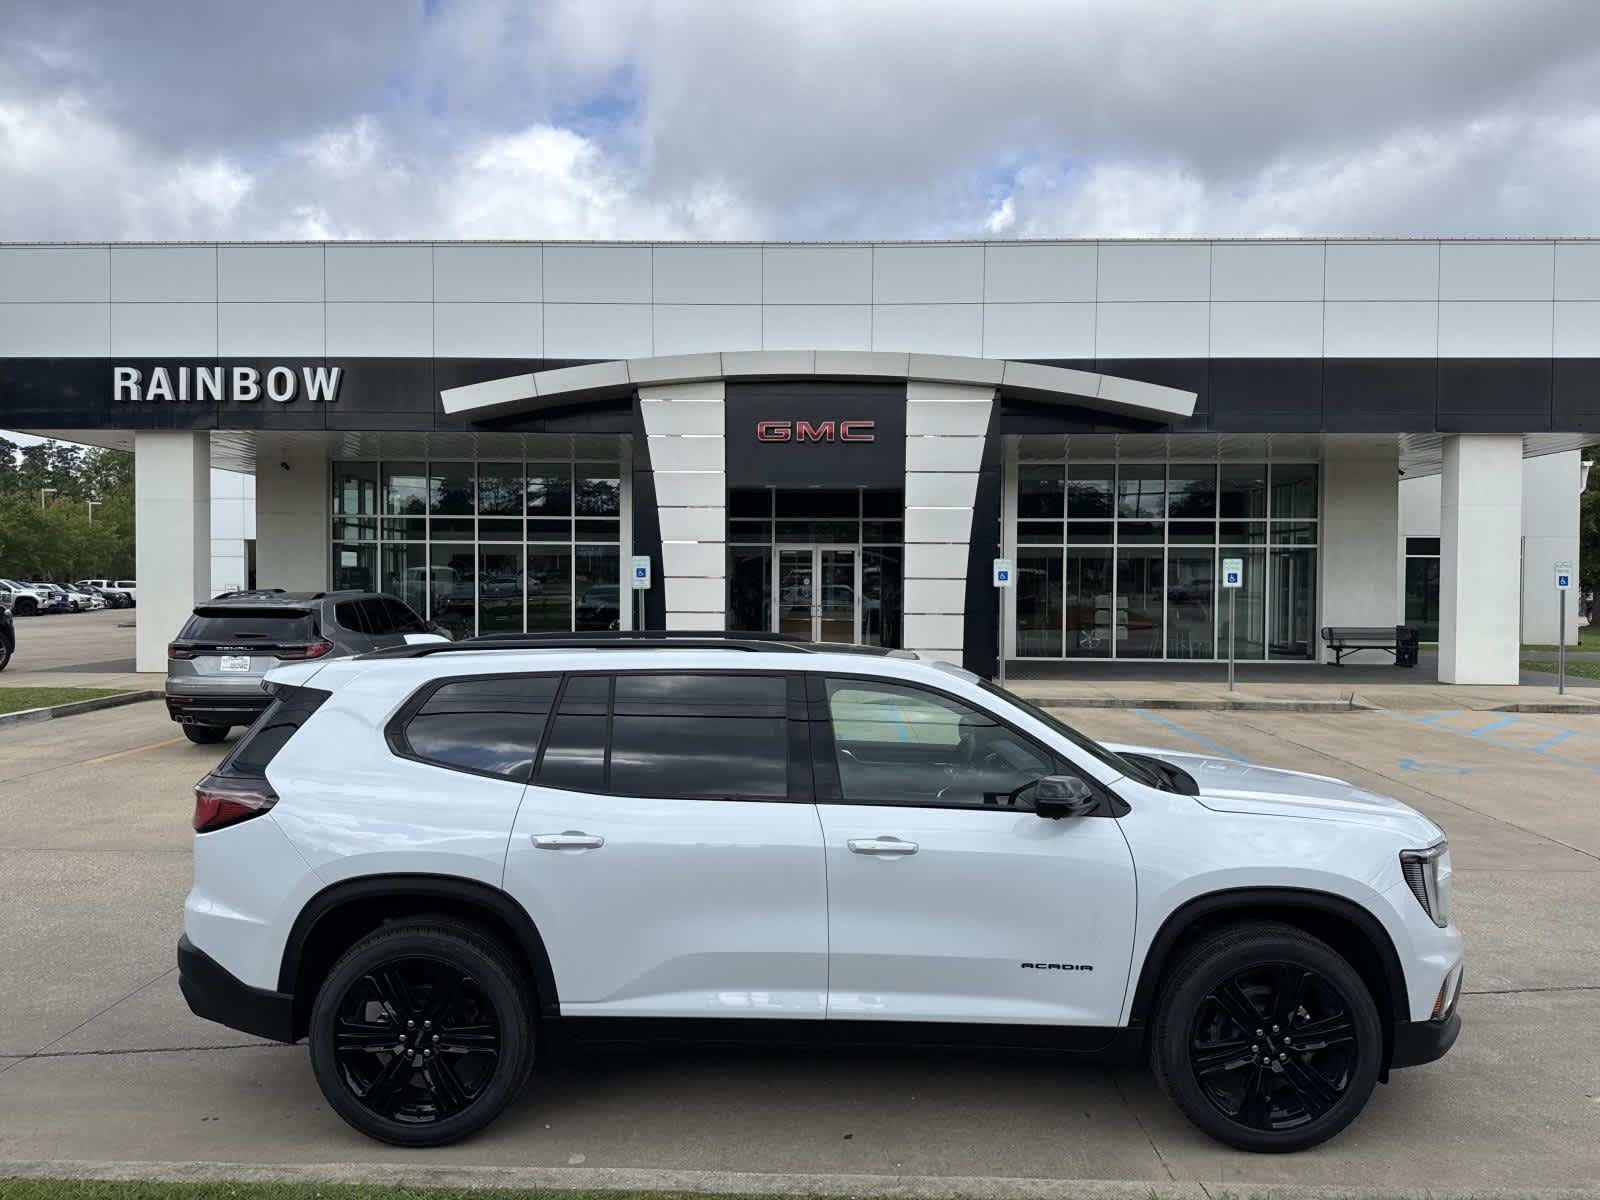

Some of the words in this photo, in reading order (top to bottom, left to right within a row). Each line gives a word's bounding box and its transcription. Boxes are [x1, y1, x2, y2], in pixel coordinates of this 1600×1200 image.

[113, 366, 341, 402] RAINBOW
[757, 421, 874, 441] GMC
[1021, 963, 1093, 971] ACADIA
